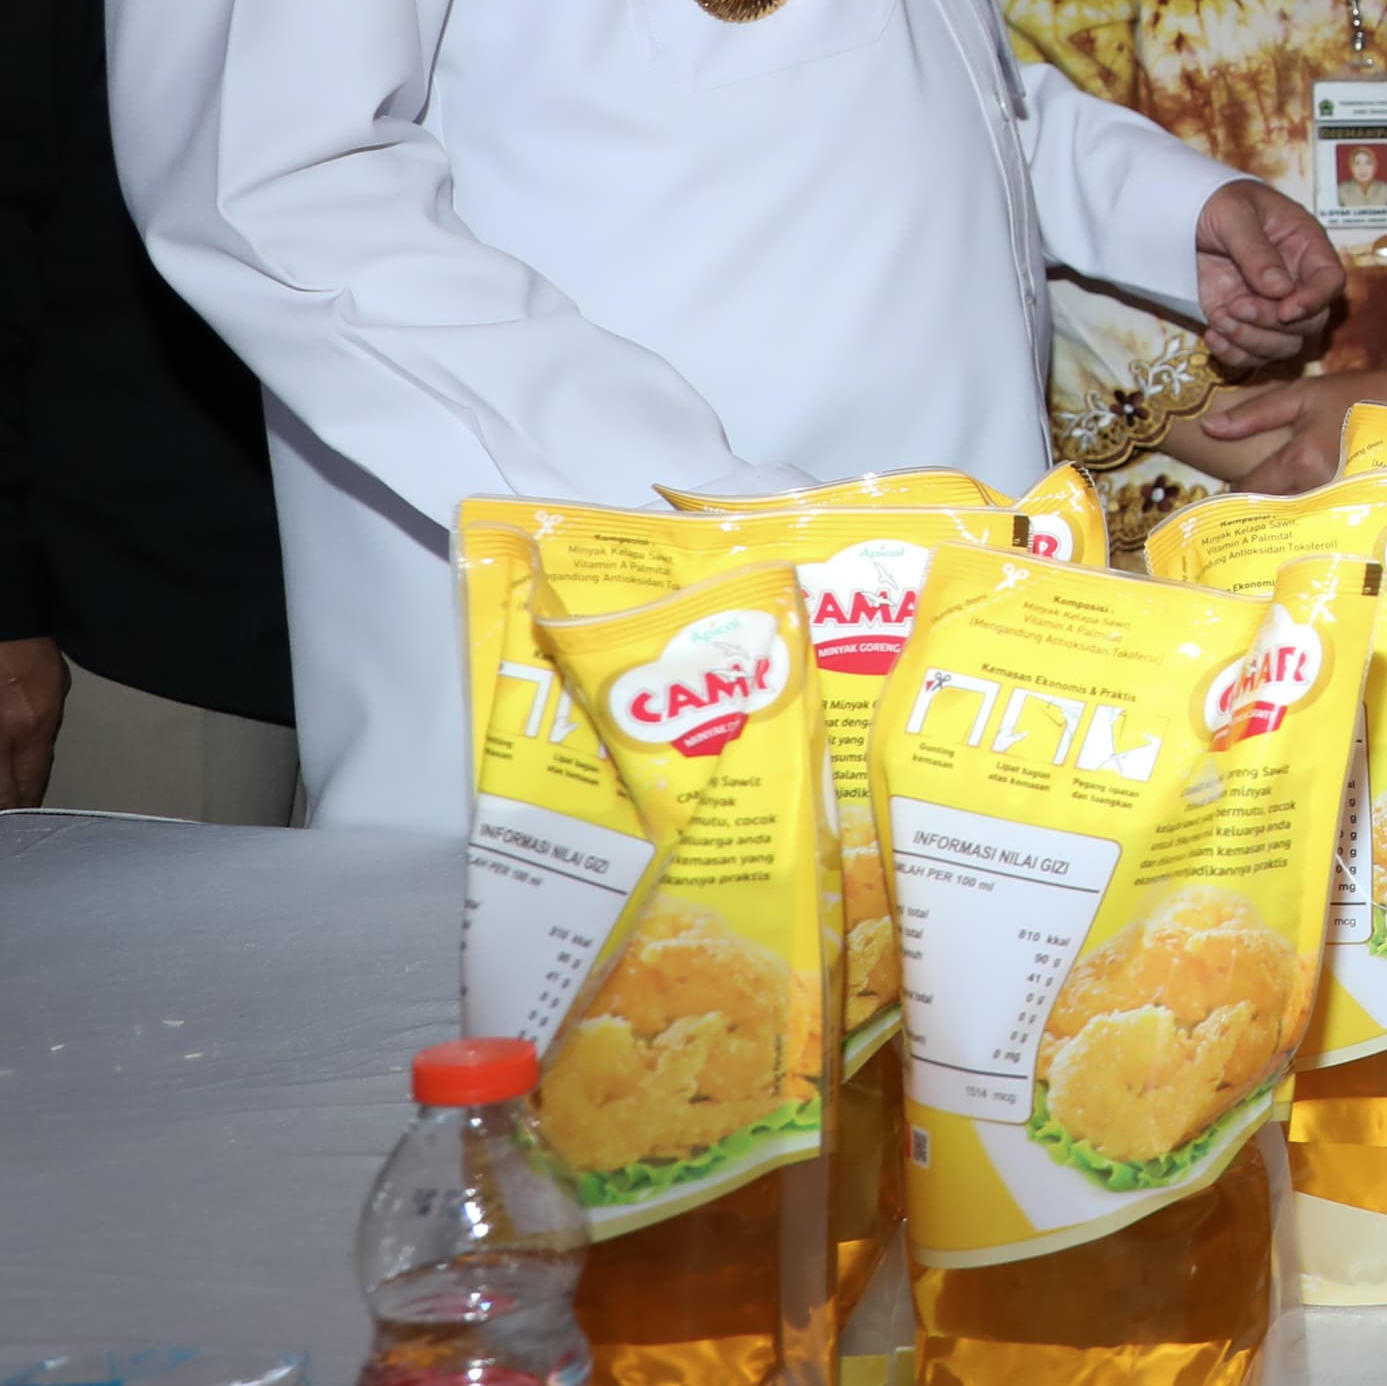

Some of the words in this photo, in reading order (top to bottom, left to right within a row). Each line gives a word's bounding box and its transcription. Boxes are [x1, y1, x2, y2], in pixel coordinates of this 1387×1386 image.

[1202, 531, 1231, 546] Minyak
[1234, 523, 1266, 536] Kelapa
[1206, 540, 1240, 556] Vitamin
[1242, 537, 1249, 545] A
[1251, 531, 1293, 543] Palmitat
[1228, 545, 1285, 561] Antioksidan
[1288, 539, 1338, 552] Tokoferol)
[1023, 601, 1060, 616] Minyak
[1063, 611, 1099, 624] Kelapa
[1053, 595, 1109, 614] Komposisi
[1024, 614, 1064, 631] Vitamin
[1066, 623, 1074, 633] A
[969, 616, 1042, 643] (Mengandung
[1045, 636, 1110, 656] Antioksidan
[818, 643, 858, 658] MINYAK
[859, 643, 901, 653] GORENG
[982, 662, 1032, 682] Kemasan
[1035, 675, 1088, 695] Ekonomis
[1090, 686, 1097, 696] &
[1100, 688, 1137, 703] Praktis
[830, 700, 870, 711] Minyak
[838, 736, 864, 746] yang
[919, 742, 955, 759] Gunting
[912, 753, 954, 769] kemasan
[996, 761, 1021, 774] Lipat
[1022, 768, 1051, 780] bagian
[1262, 764, 1290, 777] Sawit
[988, 773, 1008, 784] atas
[1010, 778, 1050, 792] kemasan
[1072, 777, 1106, 793] Pegang
[1072, 791, 1088, 801] dan
[1229, 785, 1272, 799] minyak
[1215, 824, 1265, 836] keluarga
[480, 823, 549, 854] INFORMASI
[552, 845, 583, 865] NILAI
[1217, 843, 1266, 856] kemasan
[1267, 839, 1292, 852] yang
[913, 830, 997, 861] INFORMASI
[999, 848, 1040, 869] NILAI
[1040, 858, 1071, 876] GIZI
[927, 867, 952, 883] PER
[956, 874, 976, 888] 100
[979, 880, 995, 892] ml
[1338, 883, 1356, 893] mg
[1046, 935, 1071, 947] kkal
[1027, 972, 1041, 984] 41
